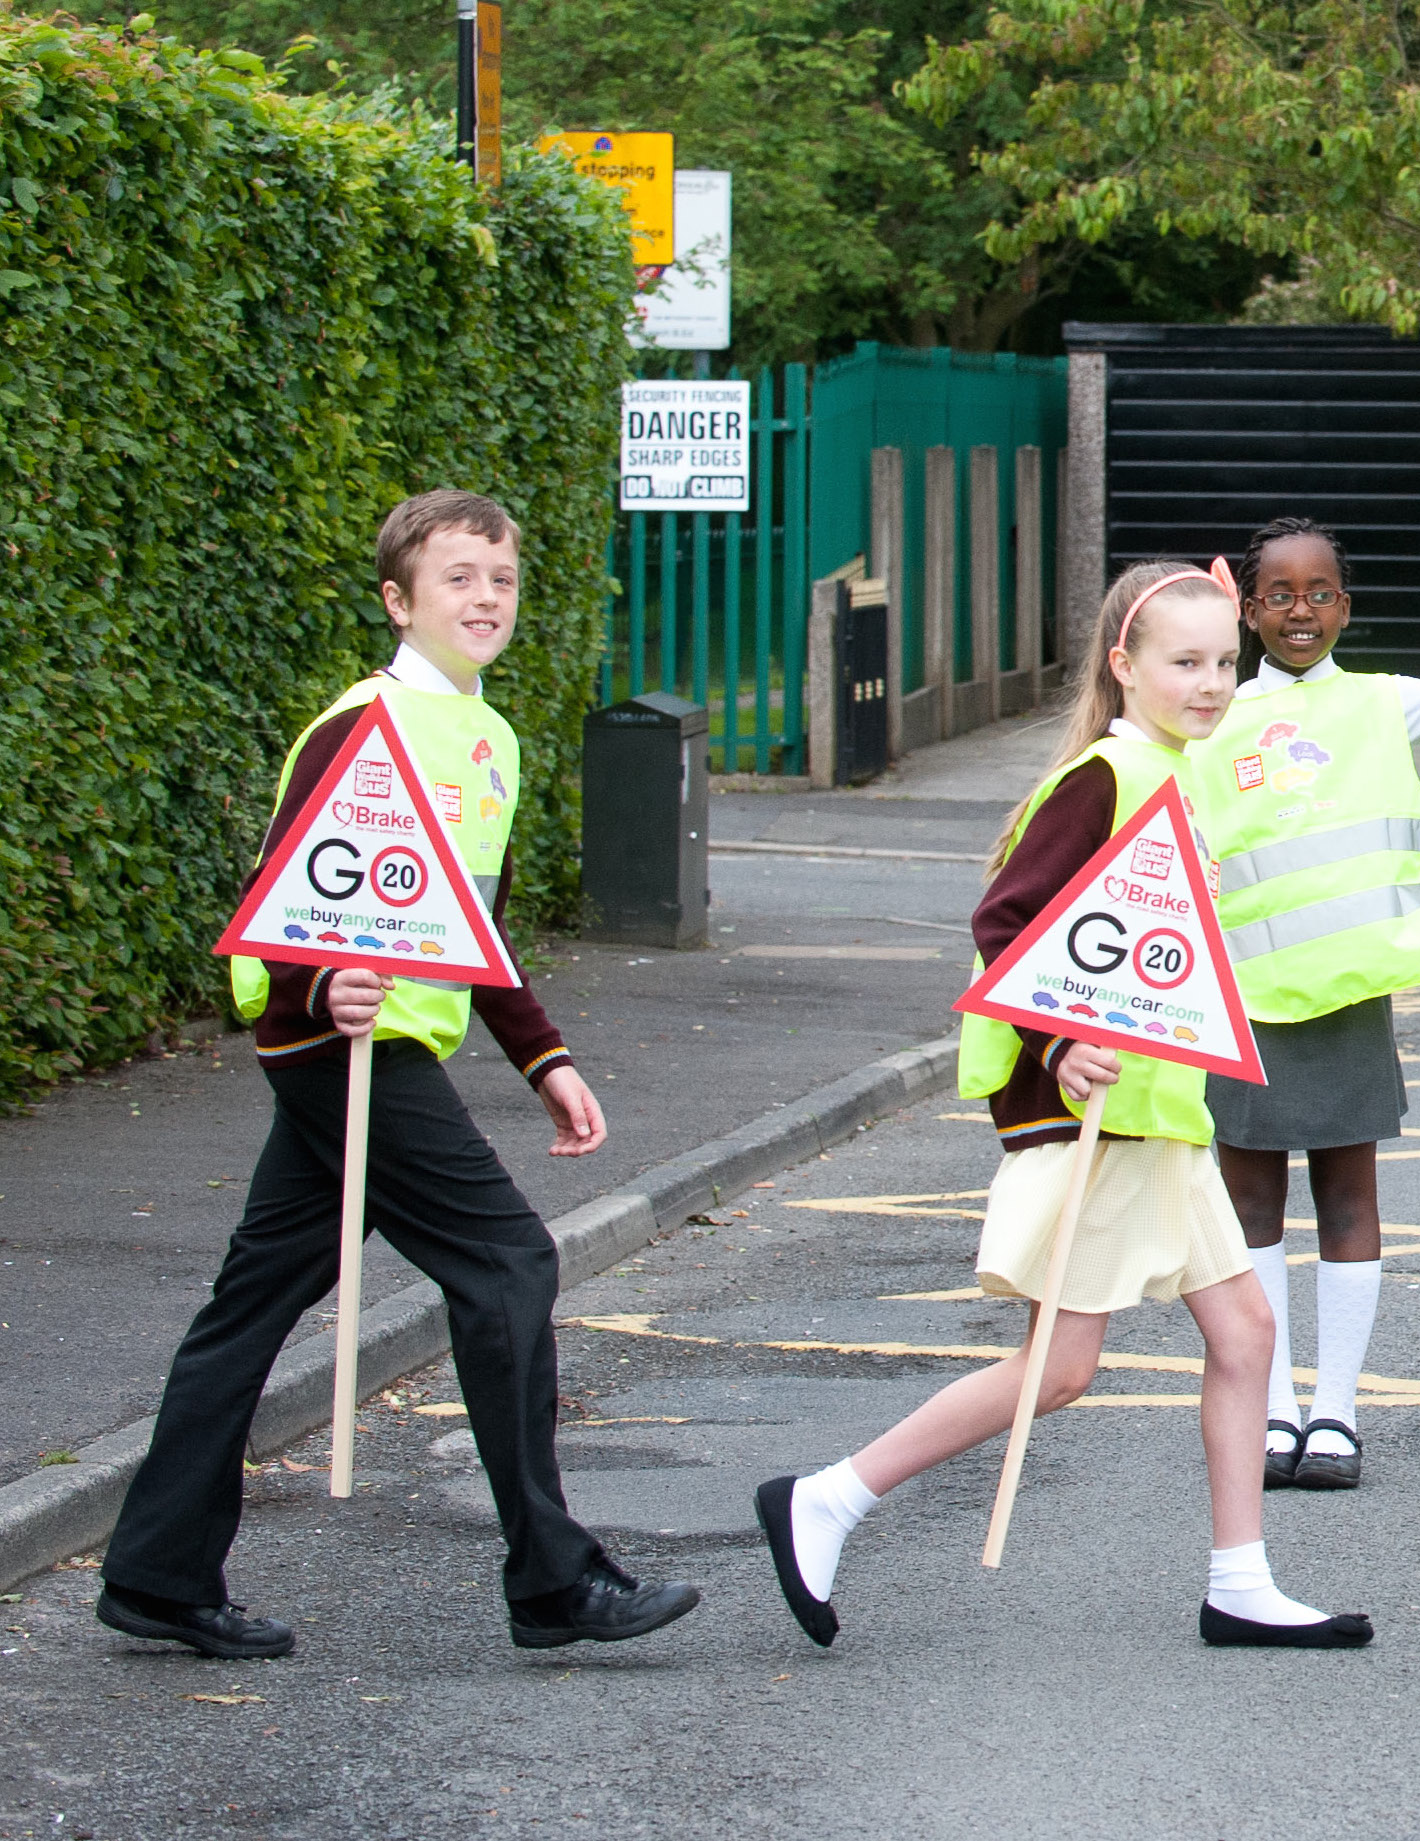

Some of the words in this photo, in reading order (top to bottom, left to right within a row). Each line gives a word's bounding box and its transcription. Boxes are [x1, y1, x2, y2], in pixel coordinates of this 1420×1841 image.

[582, 161, 655, 181] stopping
[628, 390, 686, 402] SECURITY
[691, 390, 742, 403] FENCING
[628, 411, 741, 440] DANGER
[628, 449, 684, 467] SHARP
[690, 449, 742, 467] EDGES
[626, 476, 650, 498] DO
[691, 476, 743, 498] CLIMB
[356, 761, 392, 776] Giant
[356, 806, 415, 829] Brake
[383, 863, 416, 889] 20
[1127, 883, 1190, 914] Brake
[284, 906, 447, 936] webuyanycar.com
[1144, 944, 1182, 973] 20
[1035, 972, 1205, 1025] webuyanycar.com
